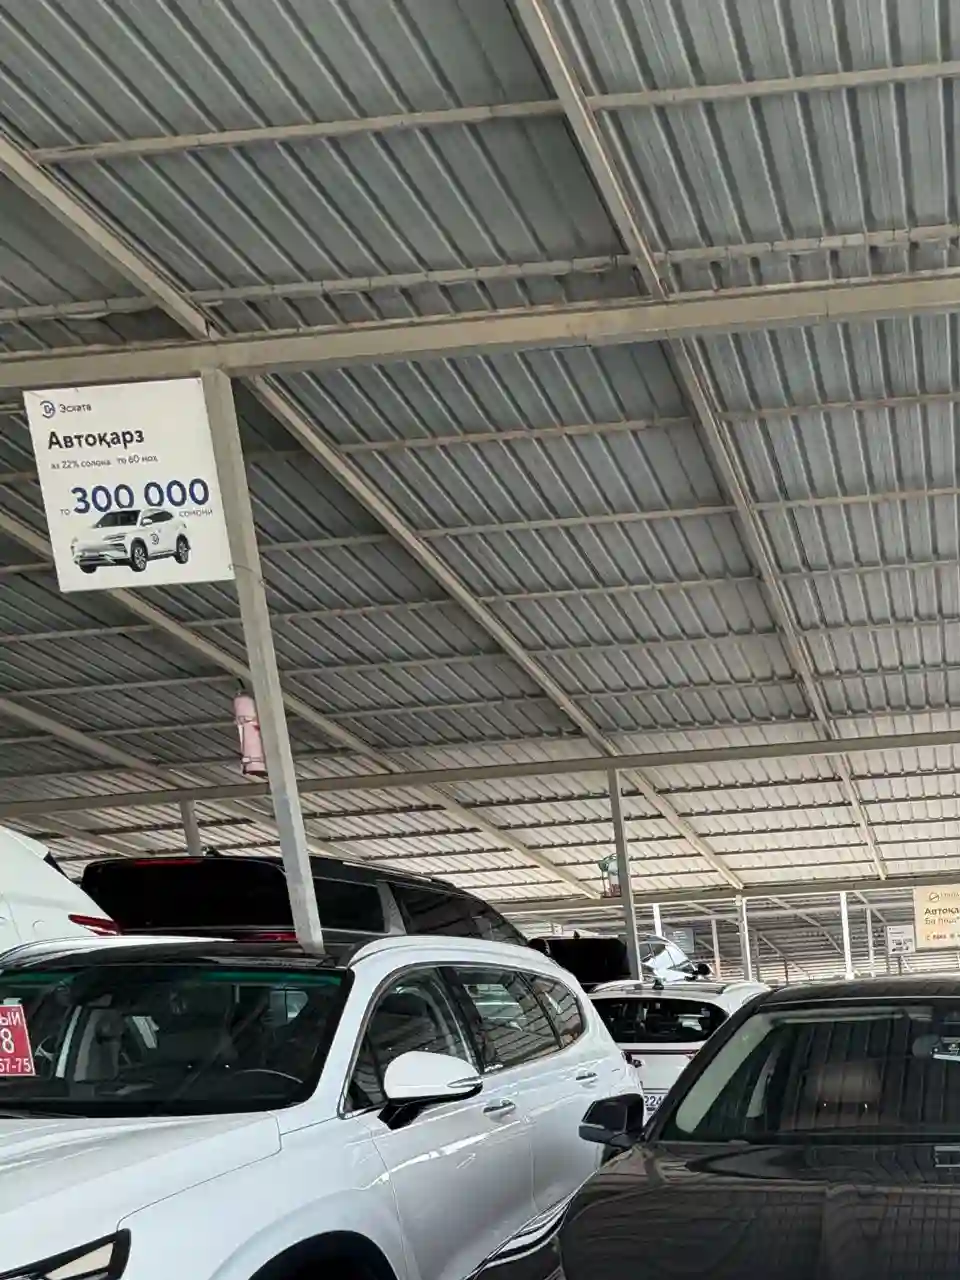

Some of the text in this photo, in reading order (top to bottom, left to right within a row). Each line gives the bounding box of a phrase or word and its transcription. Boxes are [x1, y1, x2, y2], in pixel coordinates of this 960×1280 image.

[59, 403, 92, 413] Эсхата
[48, 429, 145, 450] Автоқарз
[71, 483, 134, 514] 300
[143, 477, 210, 507] 000
